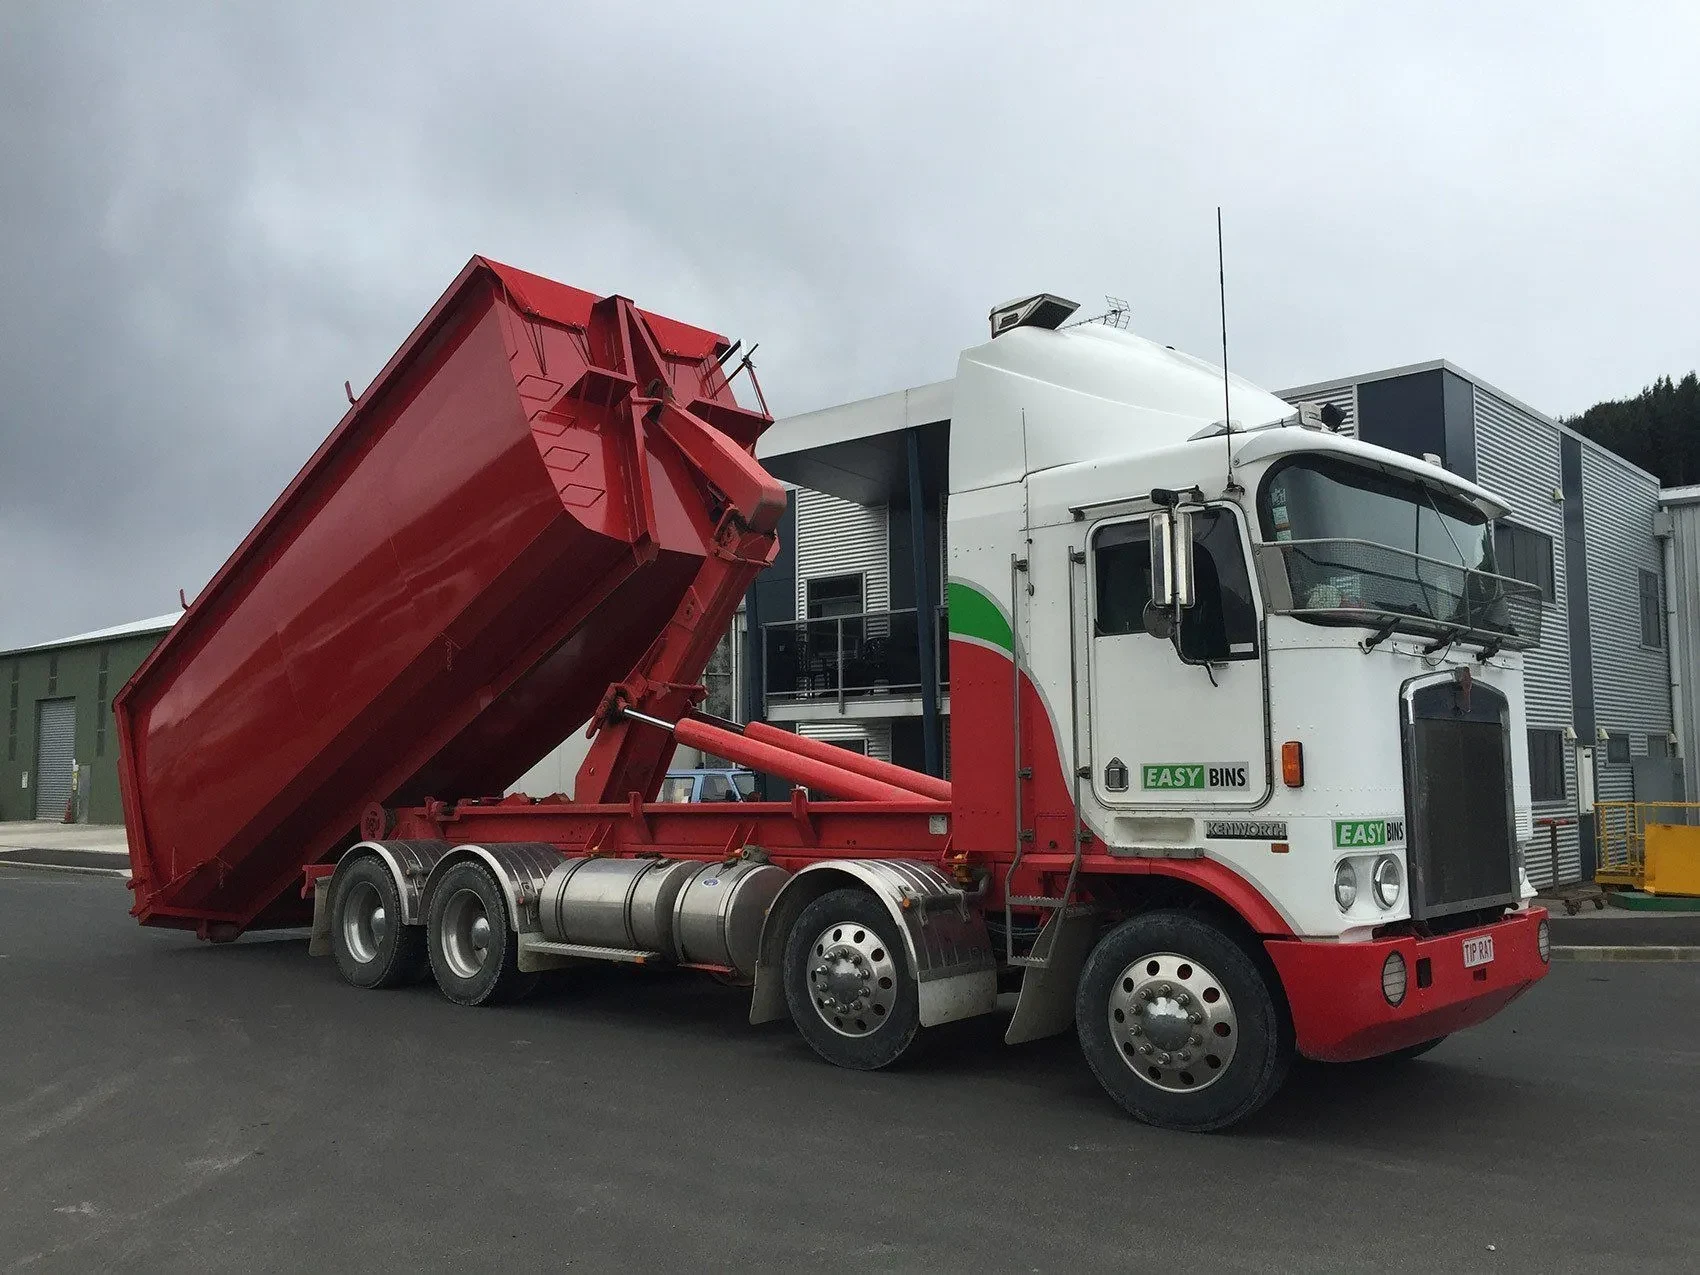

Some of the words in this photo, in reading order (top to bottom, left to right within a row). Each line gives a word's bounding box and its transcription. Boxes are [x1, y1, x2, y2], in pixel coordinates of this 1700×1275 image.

[1146, 767, 1201, 787] EASY
[1209, 767, 1246, 787] BINS
[1206, 821, 1287, 838] KENWORTH
[1340, 823, 1383, 845] EASY
[1386, 821, 1404, 842] BINS
[1464, 943, 1477, 964] TIP
[1478, 939, 1493, 960] RAT
